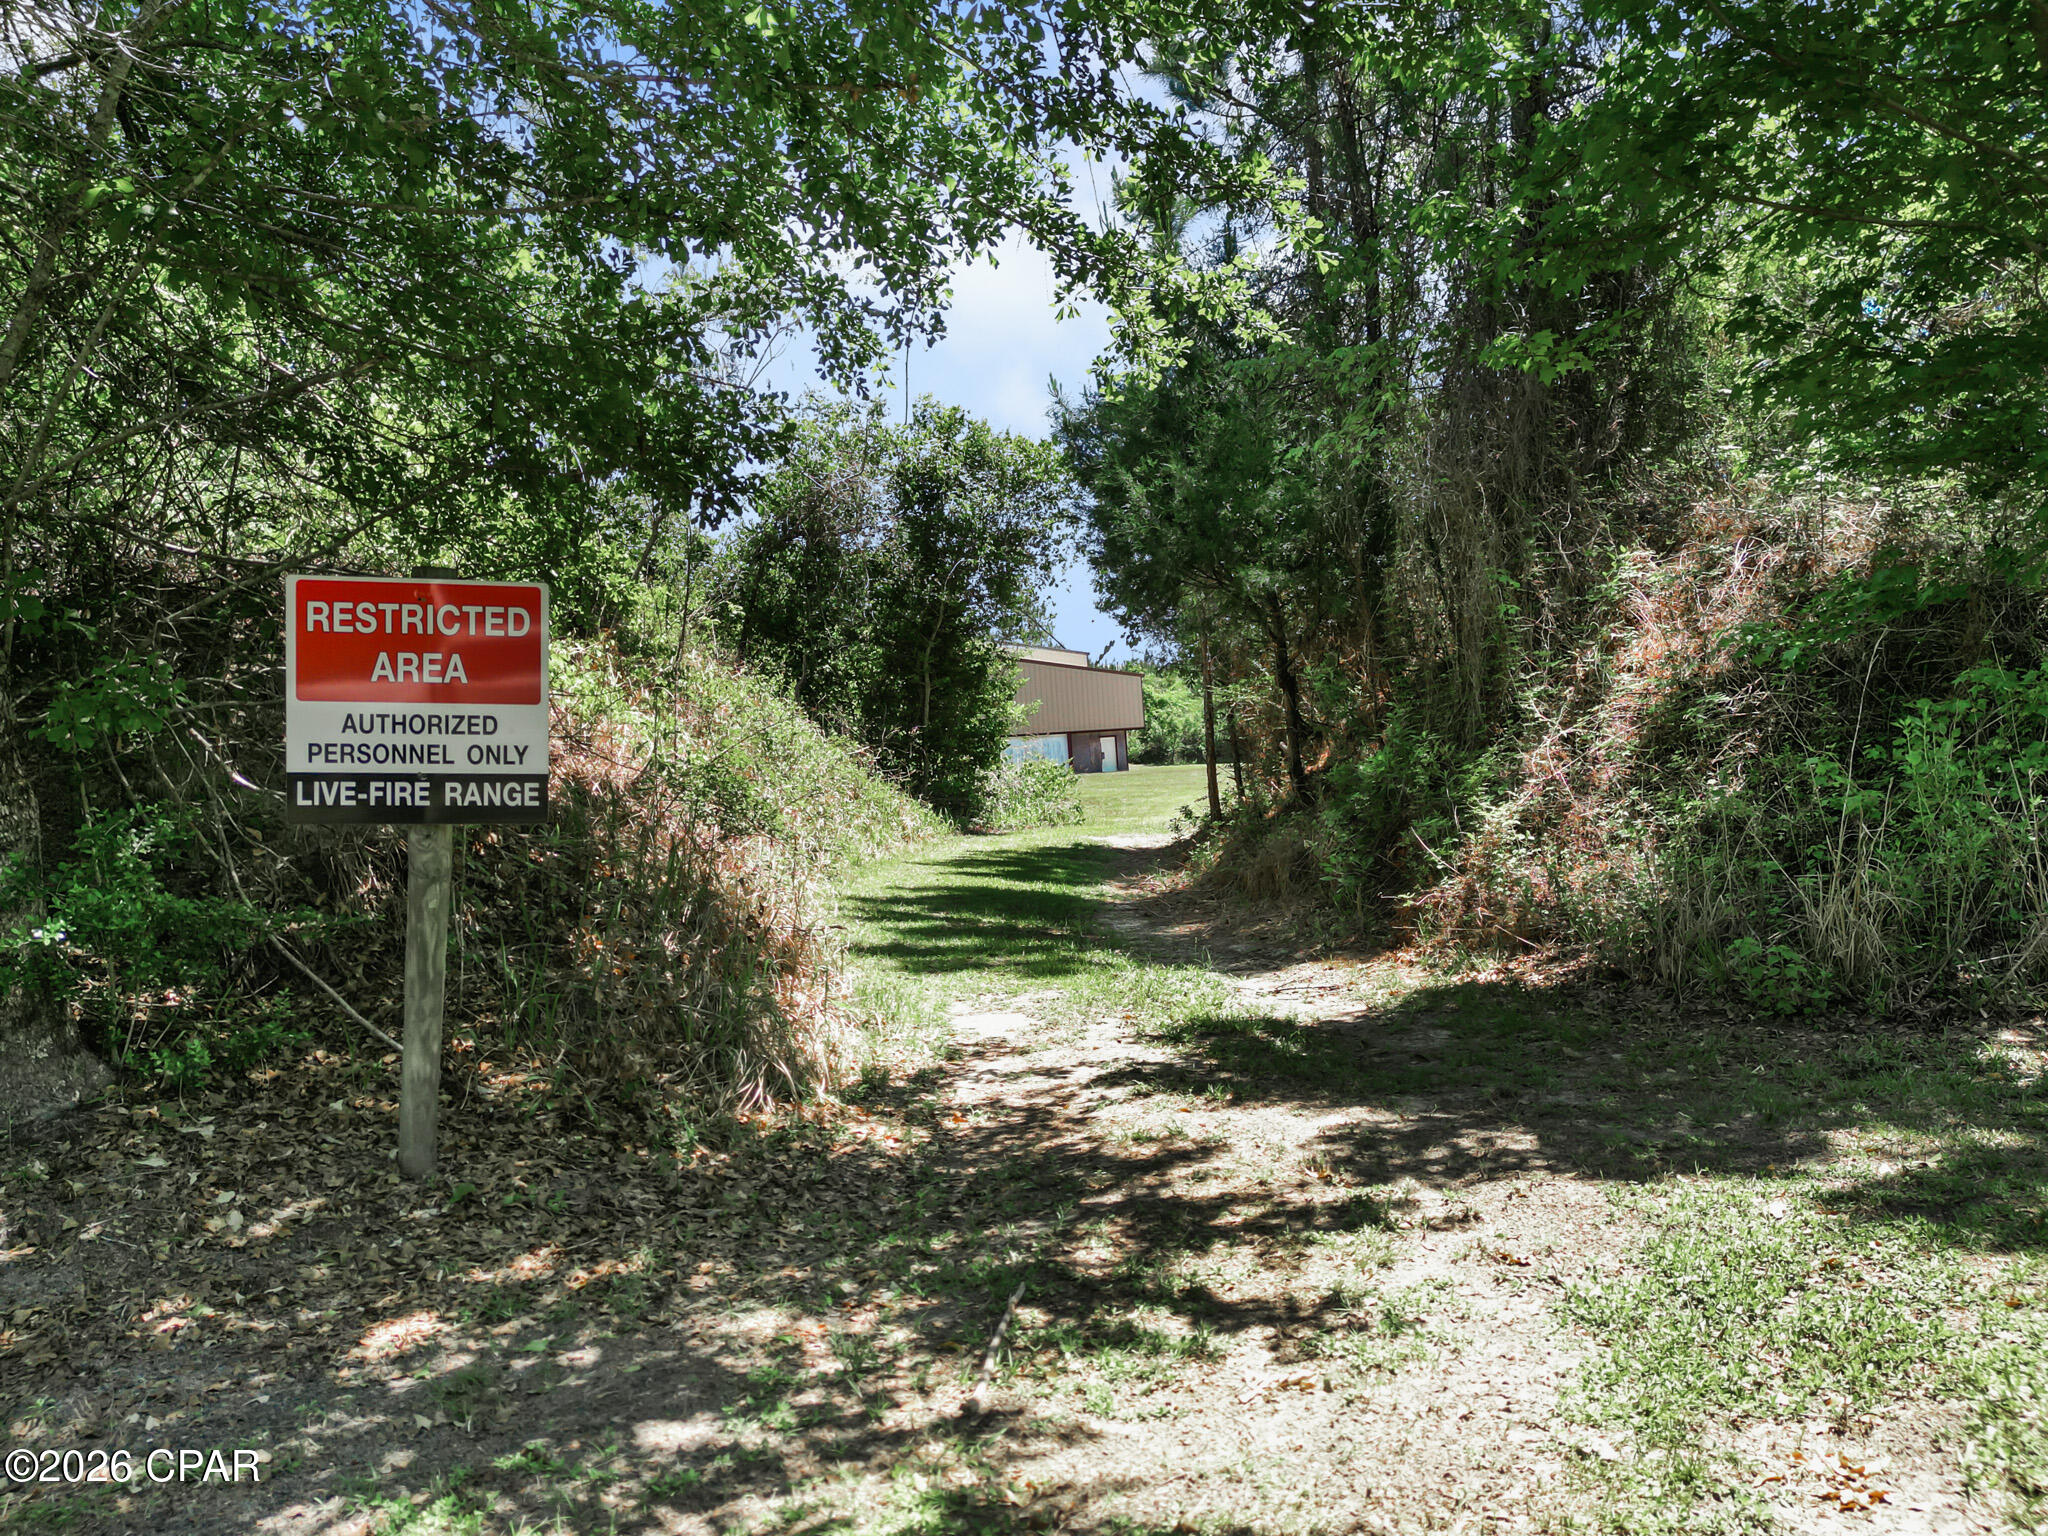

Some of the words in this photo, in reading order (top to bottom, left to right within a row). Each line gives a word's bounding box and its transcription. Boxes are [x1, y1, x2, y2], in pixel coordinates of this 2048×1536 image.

[307, 601, 531, 637] RESTRICTED
[370, 652, 468, 684] AREA
[341, 713, 498, 736] AUTHORIZED
[307, 743, 455, 765] PERSONNEL
[466, 745, 529, 766] ONLY
[296, 781, 431, 807] LIVE-FIRE
[445, 782, 540, 807] RANGE
